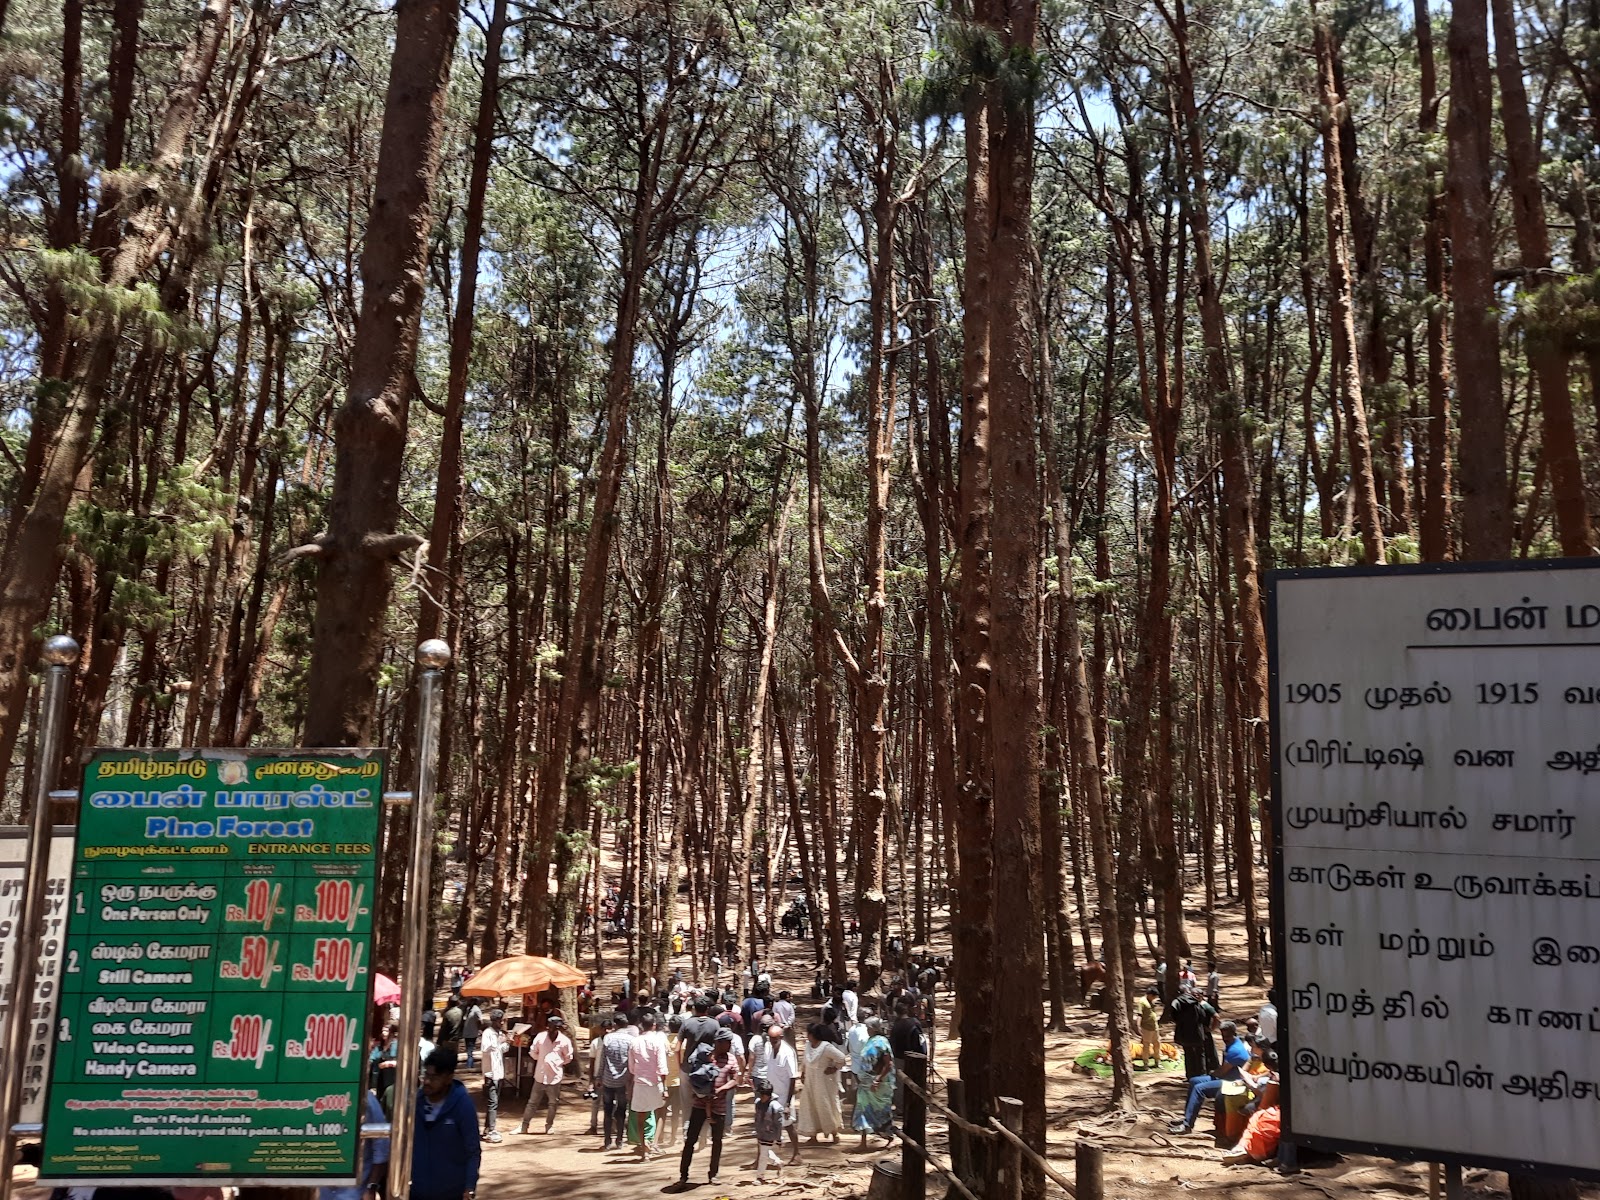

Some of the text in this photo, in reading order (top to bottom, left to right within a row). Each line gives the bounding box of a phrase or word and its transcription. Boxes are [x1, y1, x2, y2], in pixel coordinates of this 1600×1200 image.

[1426, 597, 1549, 631] பைன்
[1284, 682, 1342, 704] 1905
[1364, 681, 1451, 710] முதல்
[1476, 681, 1539, 705] 1915
[1453, 747, 1516, 768] வன
[90, 784, 374, 811] பைன் பாரஸ்ட்
[1286, 801, 1468, 830] முயற்சியால்
[144, 815, 315, 838] Pine Forest
[247, 843, 371, 855] ENTRANCE FEES
[1288, 863, 1406, 892] காடுகள்
[101, 881, 217, 903] ஒரு நபருக்கு
[102, 905, 210, 924] One Person Only
[91, 942, 211, 963] ஸ்டில் கேமரா
[1290, 922, 1344, 947] கள்
[1380, 928, 1494, 962] மற்றும்
[98, 969, 193, 984] Still Camera
[151, 997, 207, 1014] கேமரா
[1291, 982, 1449, 1021] நிறத்தில்
[92, 1018, 193, 1037] கை கேமரா
[93, 1041, 195, 1054] Video Camera
[85, 1059, 197, 1079] Handy Camera
[1294, 1048, 1494, 1090] இயற்கையின்
[169, 1114, 200, 1124] Feed
[201, 1114, 252, 1124] Animals
[73, 1127, 89, 1136] No
[90, 1127, 137, 1136] eatables
[139, 1127, 183, 1136] allowed
[184, 1126, 226, 1138] beyond
[227, 1126, 248, 1136] this
[283, 1127, 304, 1136] fine
